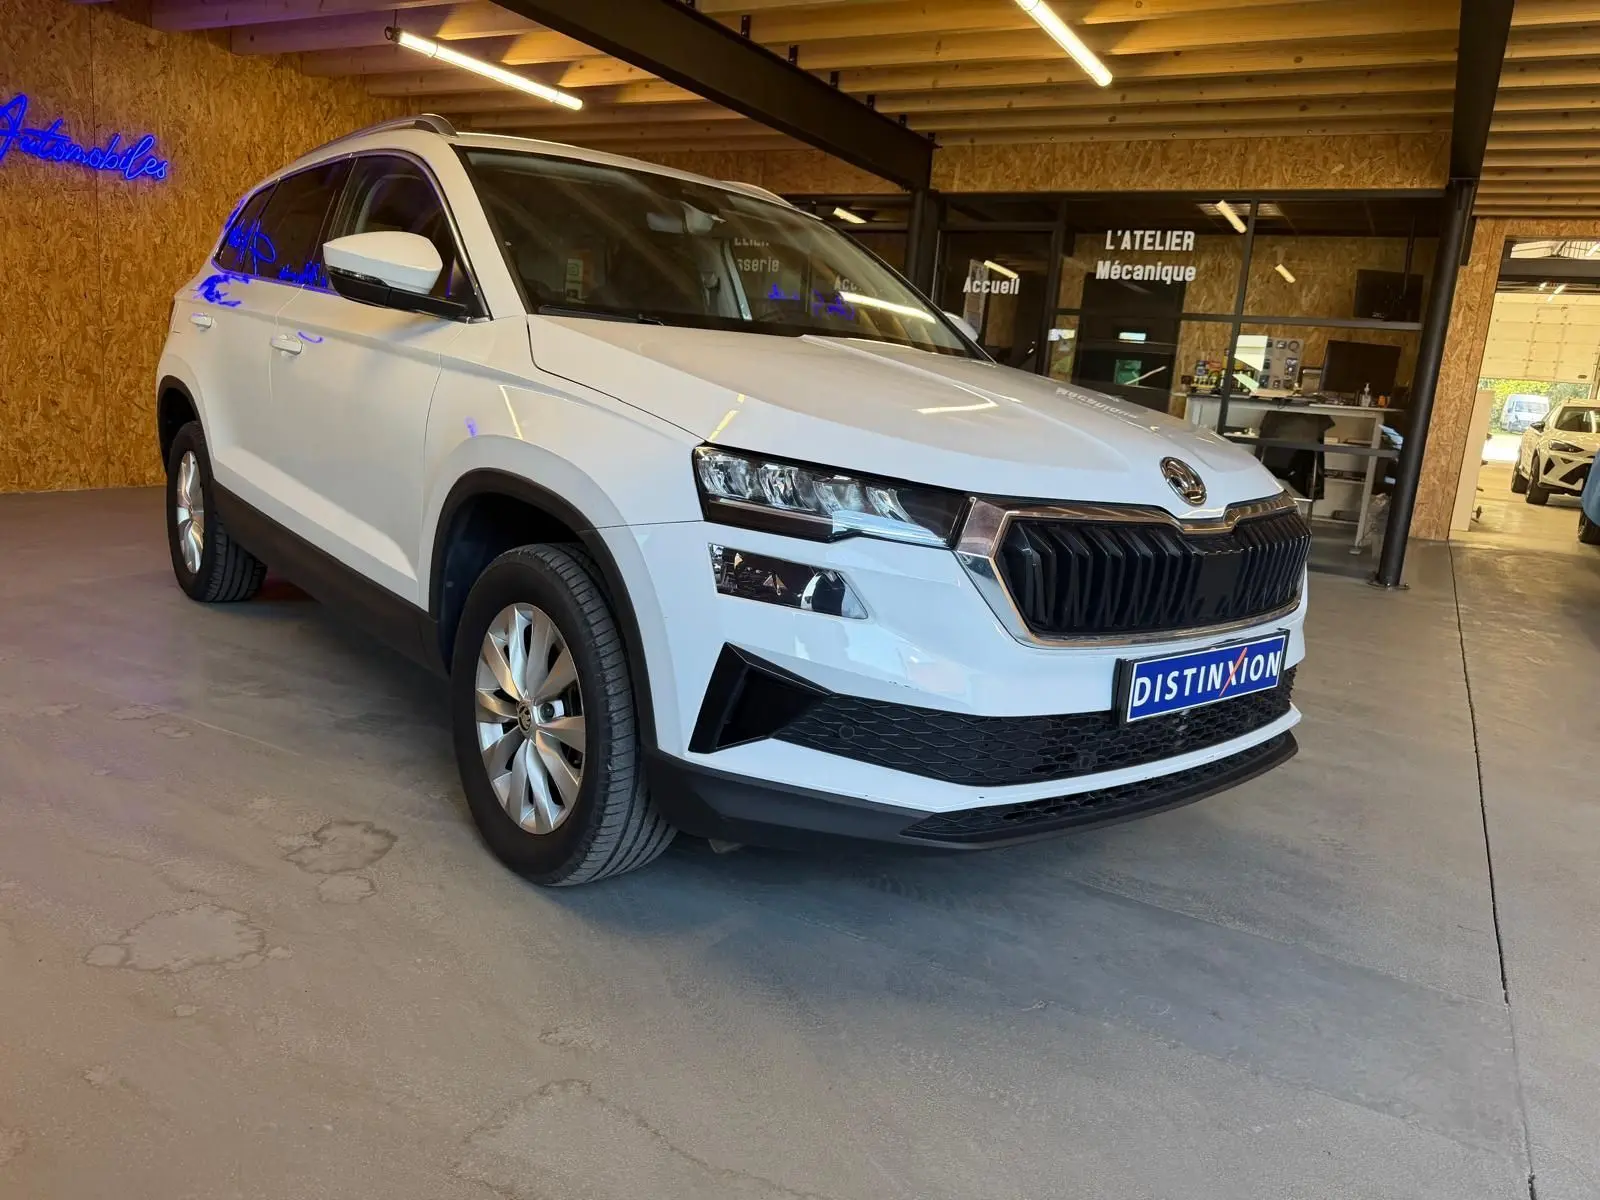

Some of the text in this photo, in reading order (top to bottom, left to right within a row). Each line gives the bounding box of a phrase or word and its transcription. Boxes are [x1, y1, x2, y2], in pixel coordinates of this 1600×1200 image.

[1105, 230, 1195, 251] L'ATELIER
[1096, 261, 1197, 285] Mécanique
[963, 277, 1020, 295] Accueil
[1133, 647, 1281, 707] DISTINXION
